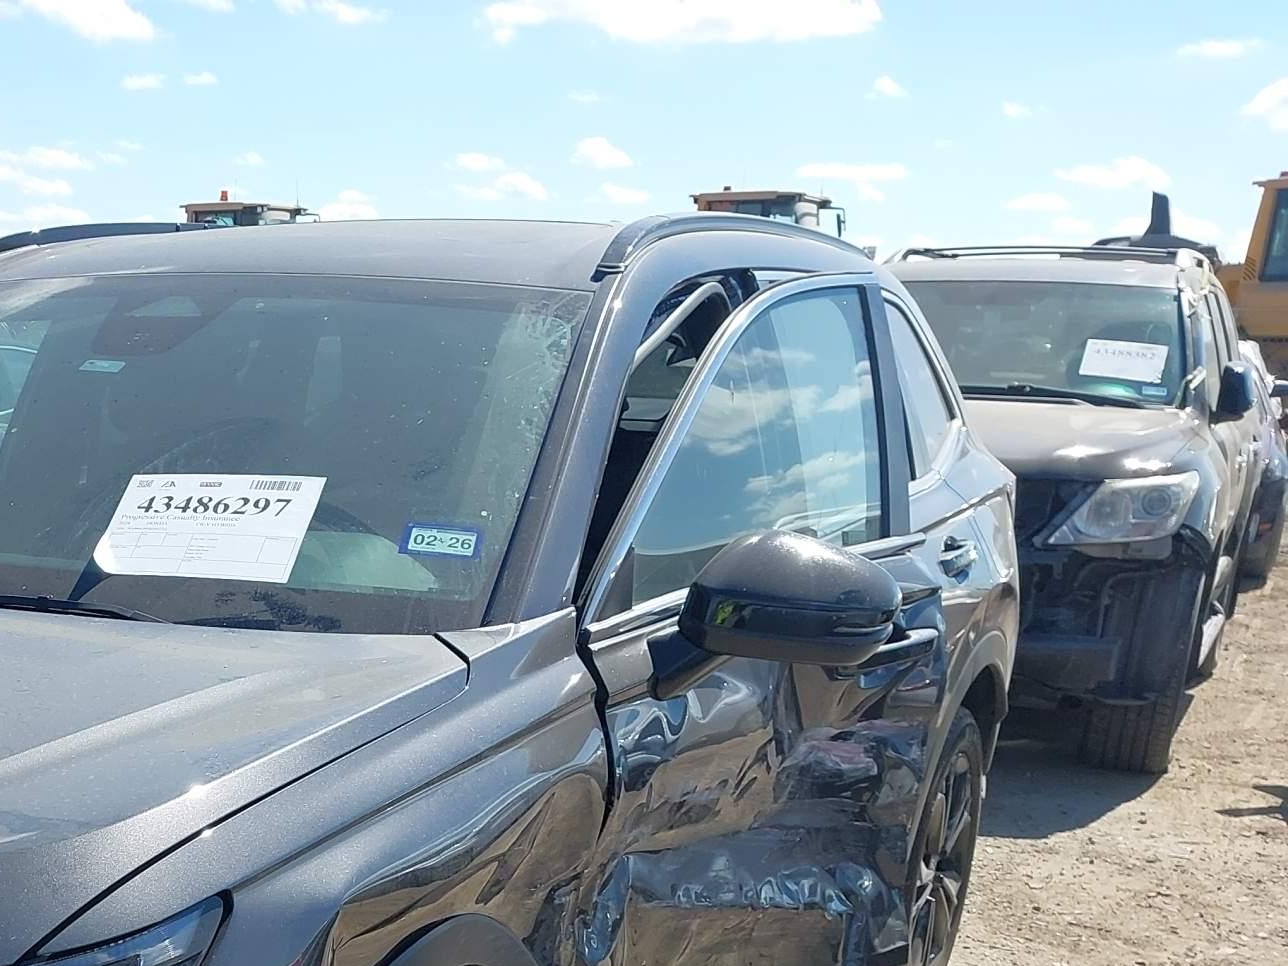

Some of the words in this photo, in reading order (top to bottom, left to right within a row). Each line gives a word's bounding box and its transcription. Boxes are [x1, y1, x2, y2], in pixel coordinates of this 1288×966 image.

[137, 495, 294, 517] 43486297
[121, 513, 165, 521] Progressive
[166, 514, 200, 522] Casualty
[202, 514, 241, 522] Insurance
